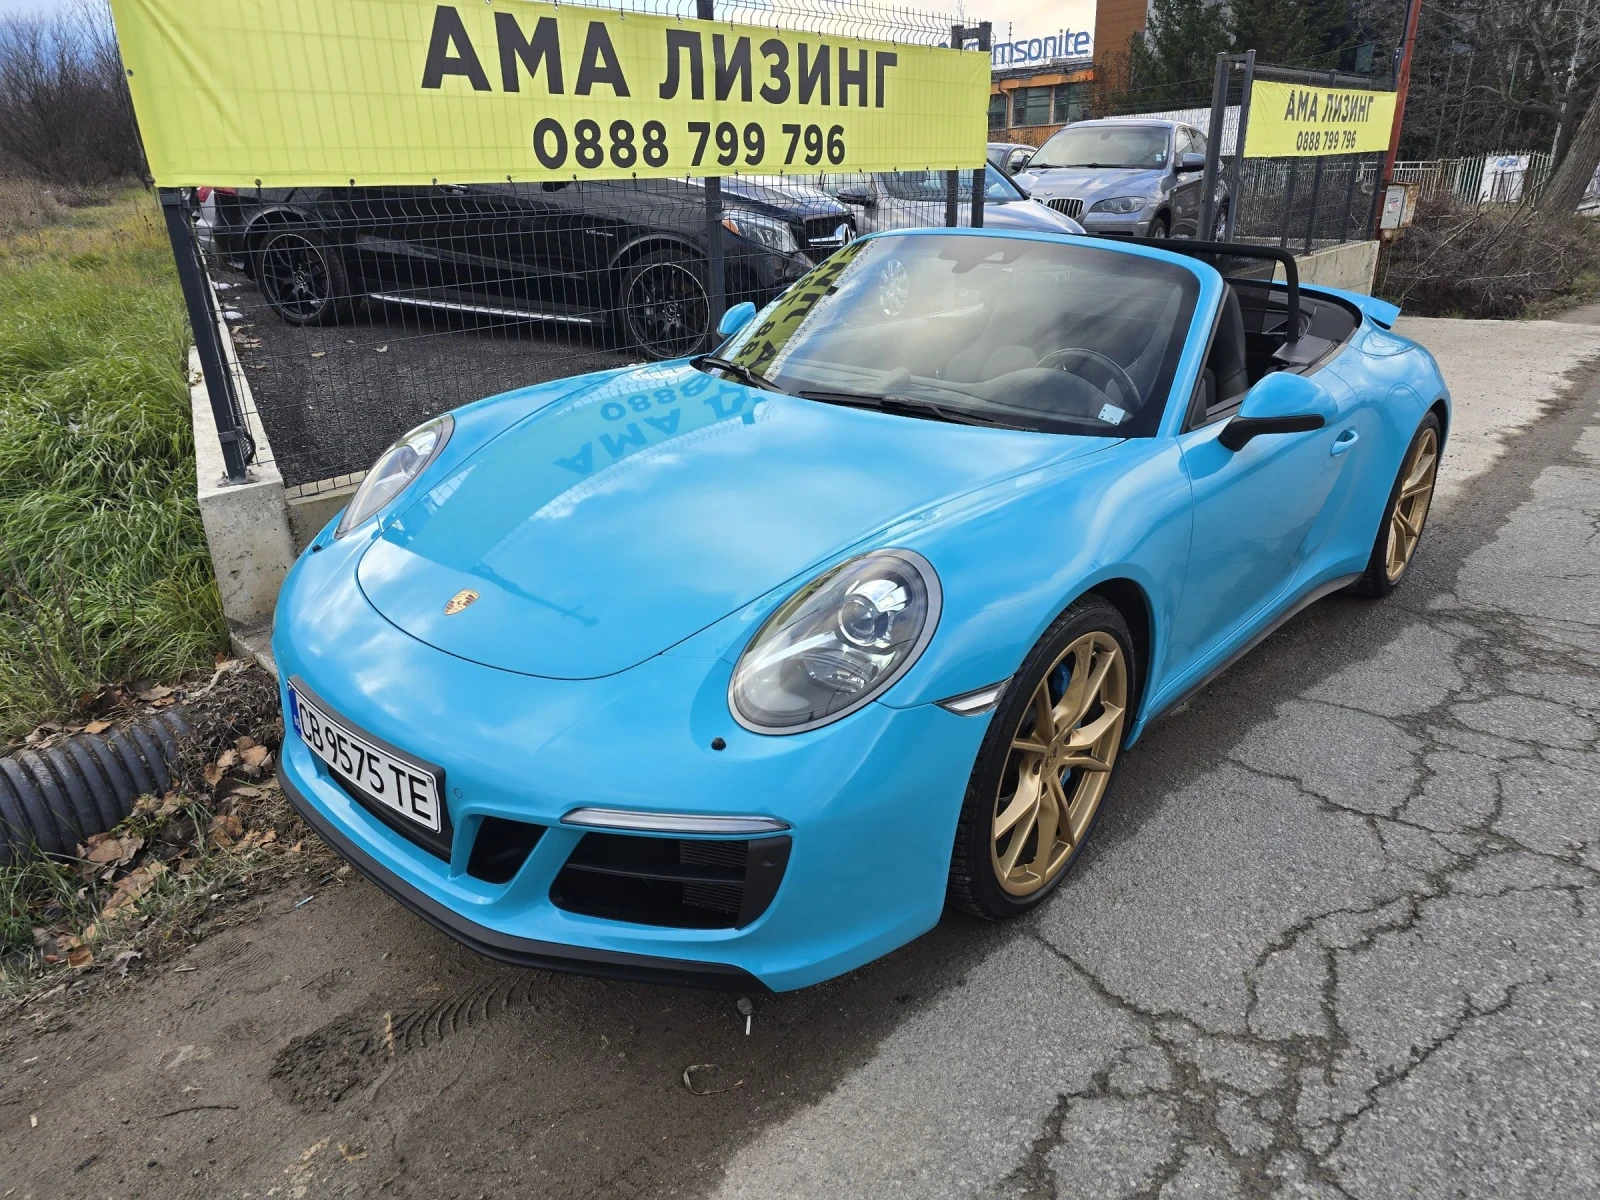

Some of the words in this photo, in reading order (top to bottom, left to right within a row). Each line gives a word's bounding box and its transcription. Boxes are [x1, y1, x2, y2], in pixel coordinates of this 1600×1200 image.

[421, 5, 631, 97] АМА
[659, 28, 897, 108] ЛИЗИНГ
[938, 29, 1090, 65] msonite
[1284, 89, 1318, 122] АМА
[1321, 93, 1374, 122] ЛИЗИНГ
[533, 117, 669, 169] 0888
[687, 121, 765, 167] 799
[782, 123, 846, 165] 796
[1296, 130, 1321, 151] 0888
[1322, 130, 1339, 150] 799
[1340, 130, 1356, 149] 796
[299, 702, 324, 752] CB
[325, 726, 384, 795] 9575
[388, 763, 431, 821] TE
